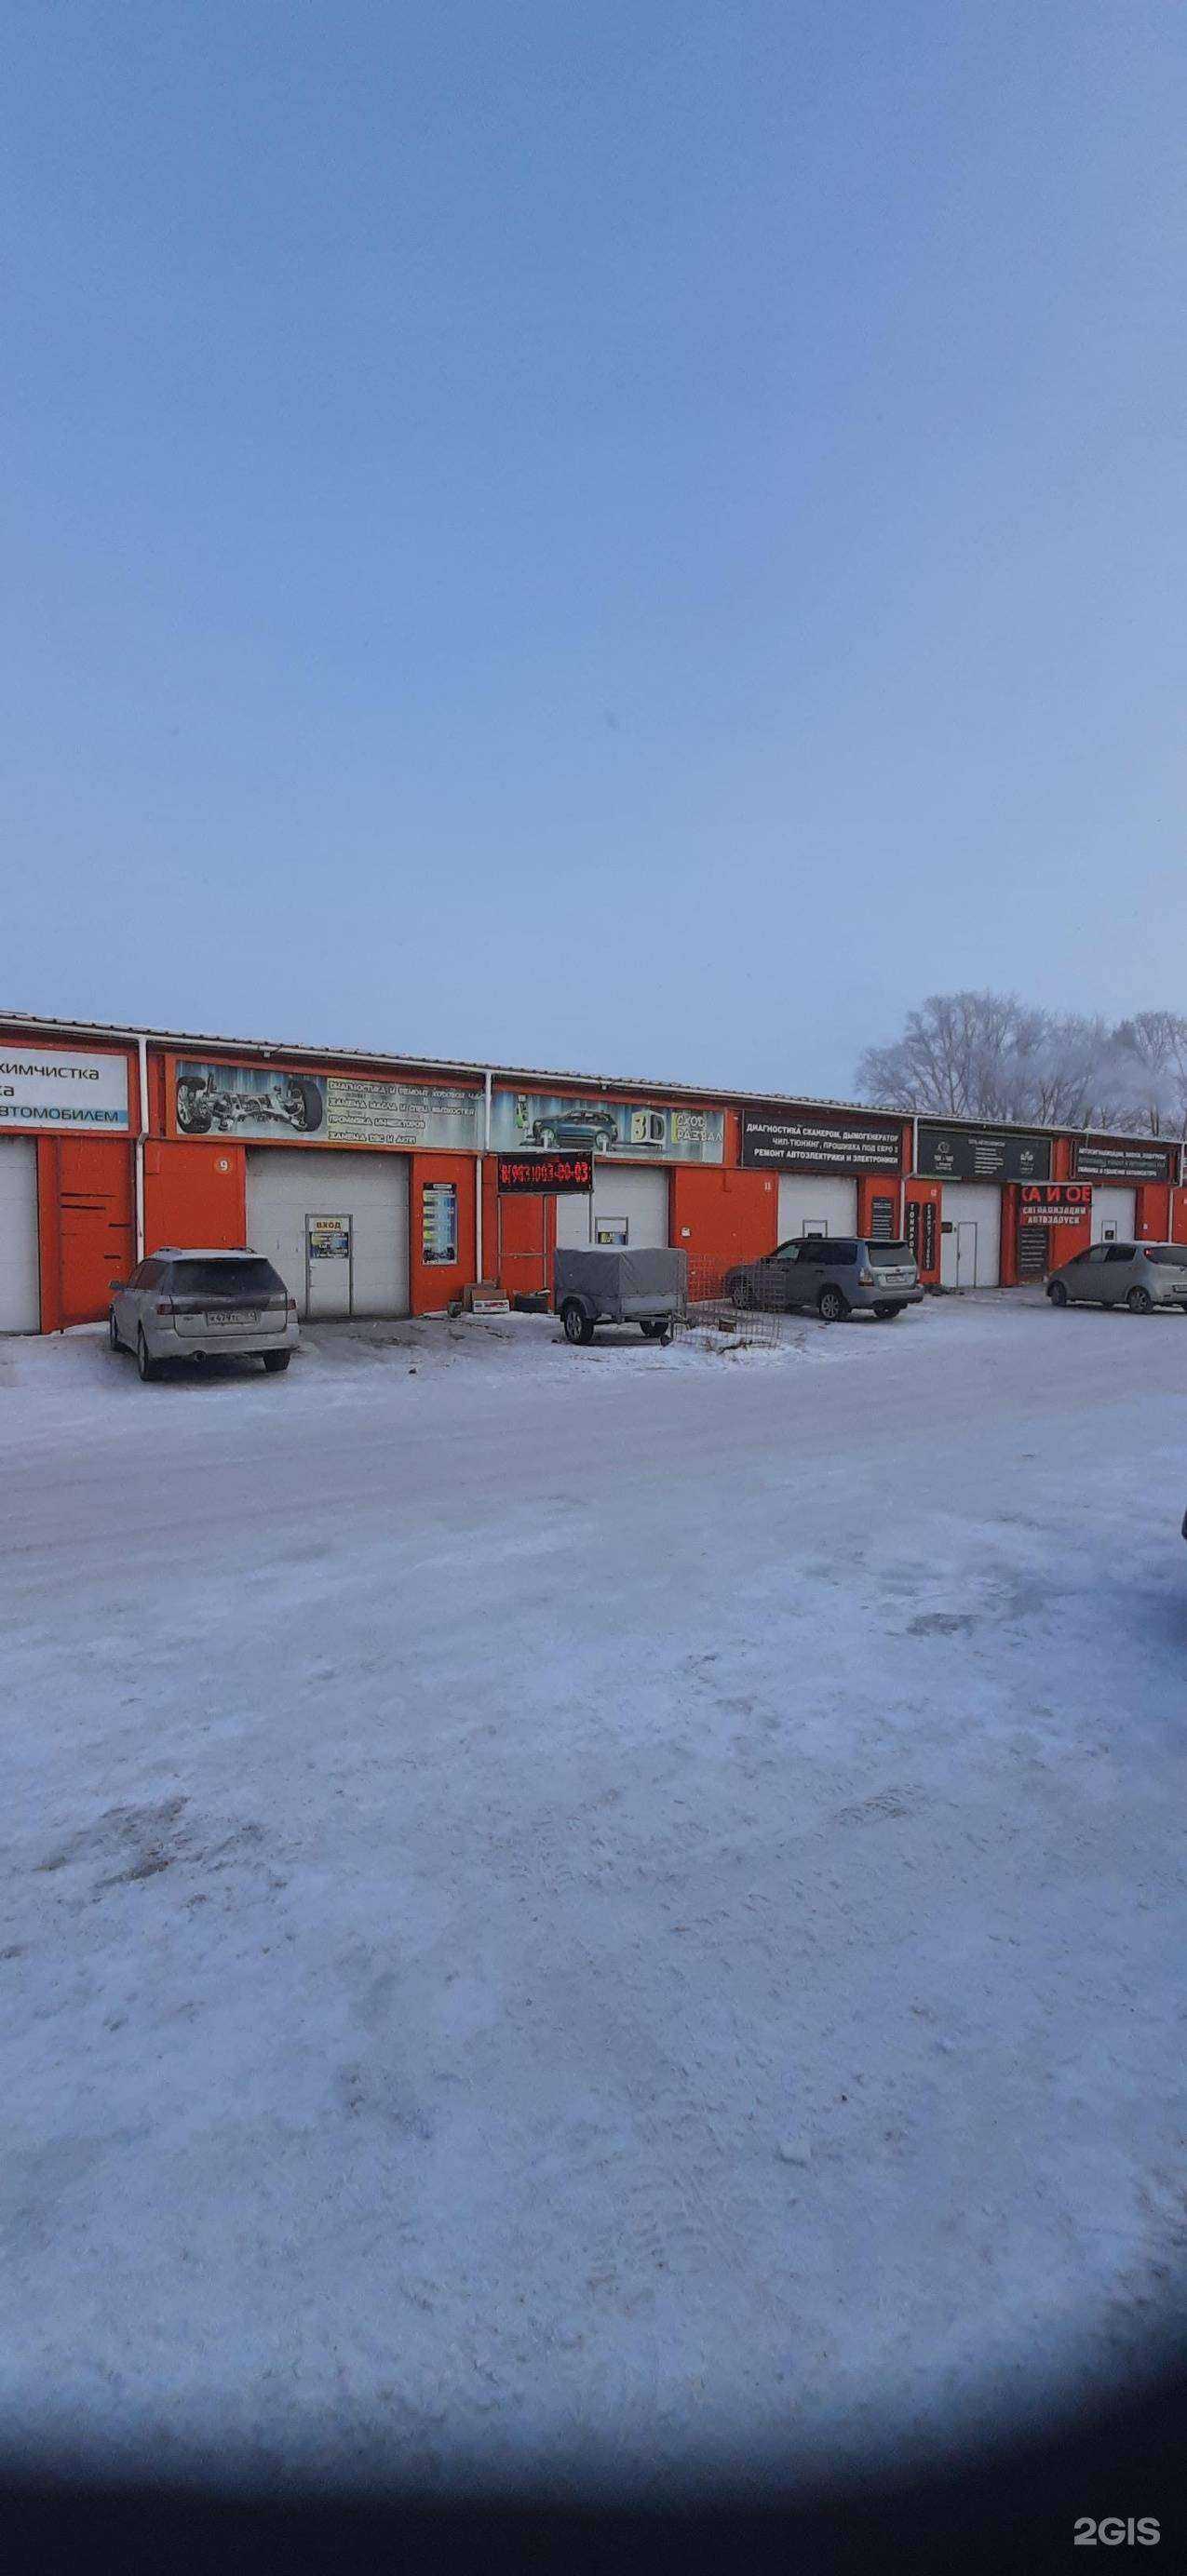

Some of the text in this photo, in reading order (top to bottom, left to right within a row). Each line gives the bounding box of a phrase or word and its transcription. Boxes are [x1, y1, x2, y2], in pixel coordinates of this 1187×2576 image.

[747, 1123, 802, 1135] ДИАГНОСТИКА
[754, 1149, 785, 1159] РЕМОНТ
[220, 1161, 228, 1171] 9
